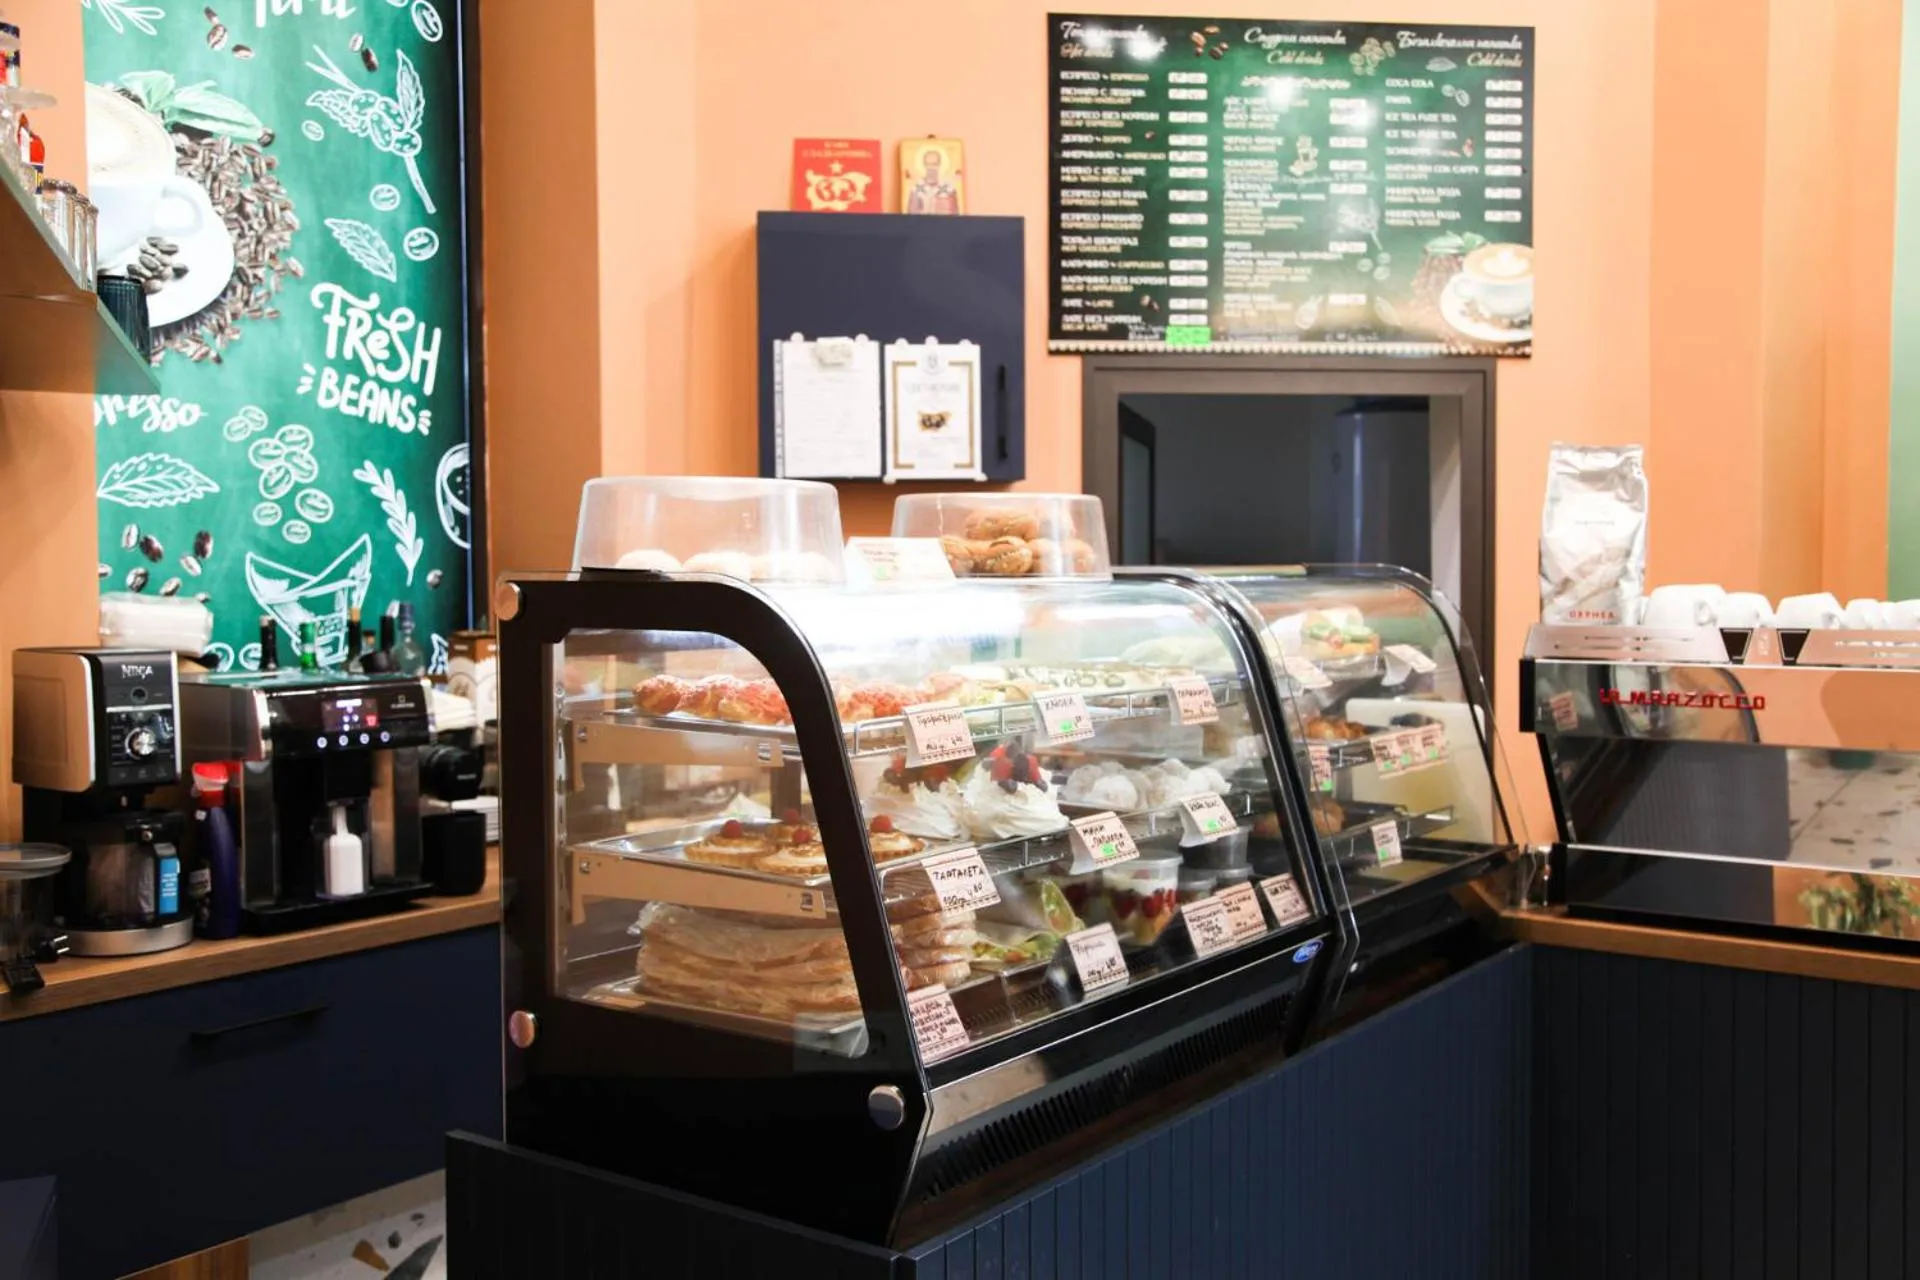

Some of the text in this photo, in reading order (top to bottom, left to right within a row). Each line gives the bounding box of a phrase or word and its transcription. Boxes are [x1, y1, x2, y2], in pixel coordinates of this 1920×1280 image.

[1467, 53, 1494, 66] Cold
[1386, 78, 1434, 88] COCA COLA
[317, 366, 417, 433] BEANS
[121, 664, 154, 679] NINJA
